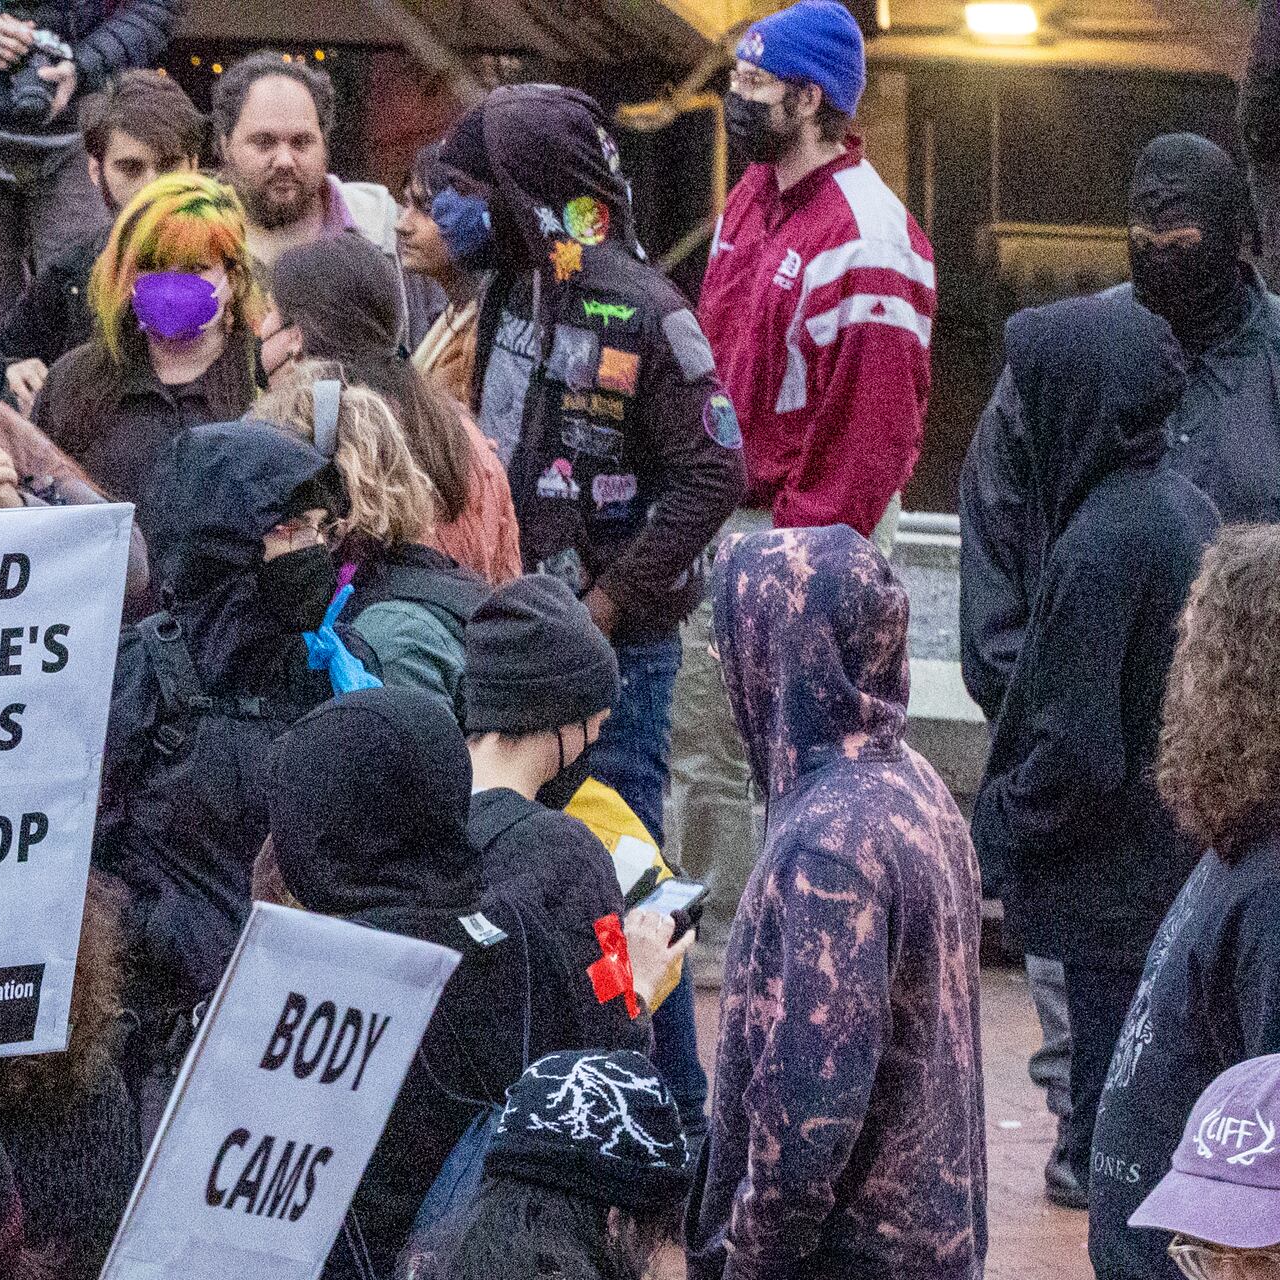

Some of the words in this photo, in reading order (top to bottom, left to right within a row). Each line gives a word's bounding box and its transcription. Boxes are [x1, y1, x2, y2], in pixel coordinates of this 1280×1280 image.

[259, 991, 392, 1091] BODY
[205, 1127, 334, 1222] CAMS
[1093, 1151, 1141, 1183] ONES
